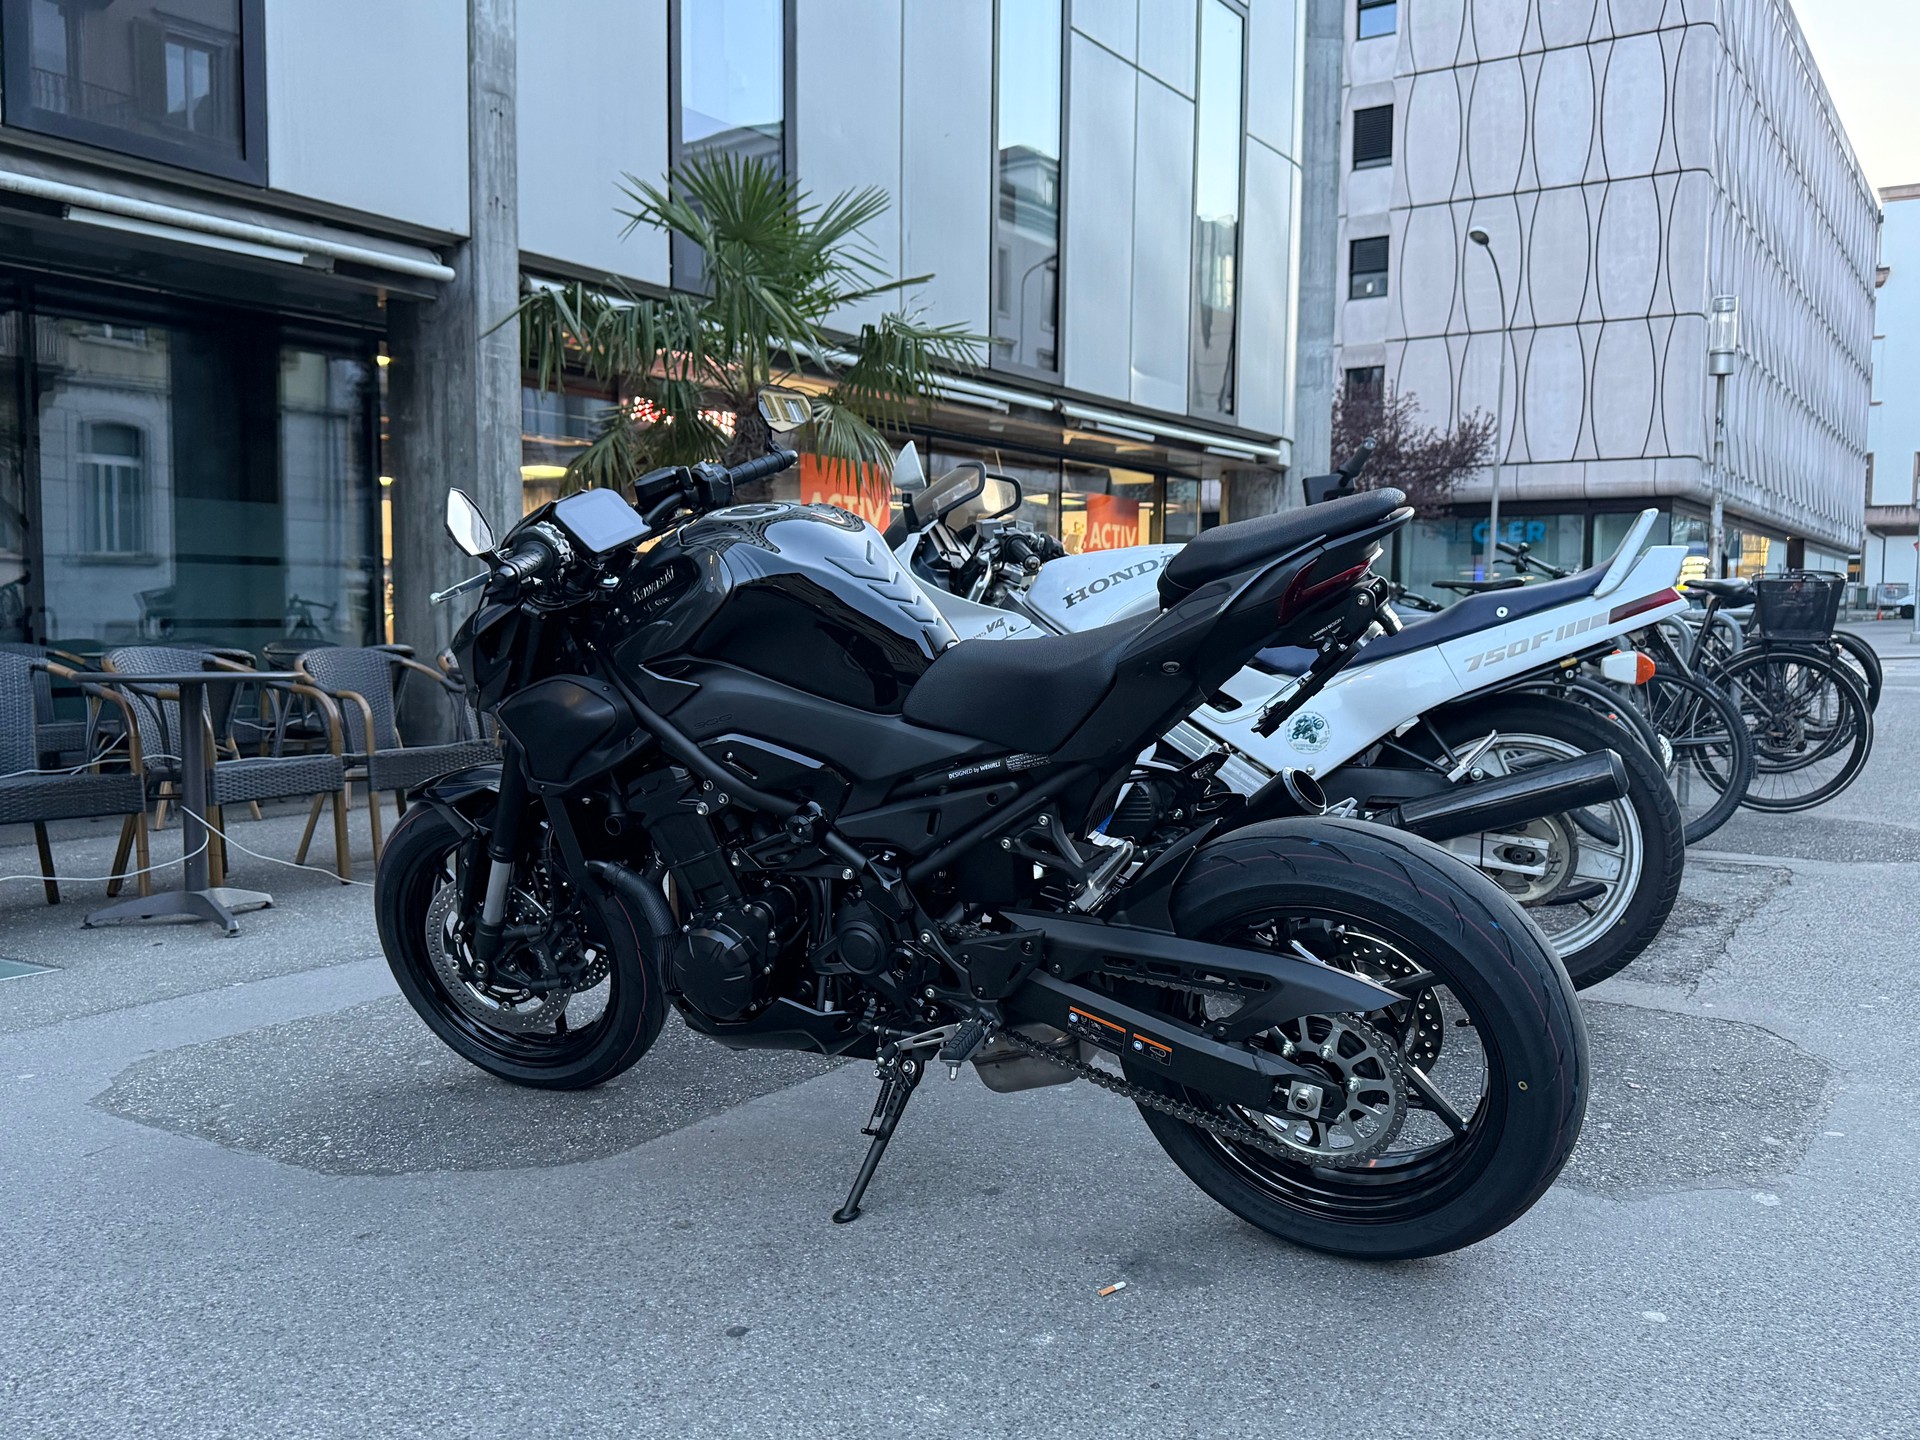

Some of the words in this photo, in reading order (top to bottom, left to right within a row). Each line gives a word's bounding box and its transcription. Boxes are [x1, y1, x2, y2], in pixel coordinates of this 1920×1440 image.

[1089, 521, 1138, 549] ACTIV
[985, 616, 1006, 634] V4
[948, 768, 973, 779] DESIGNED
